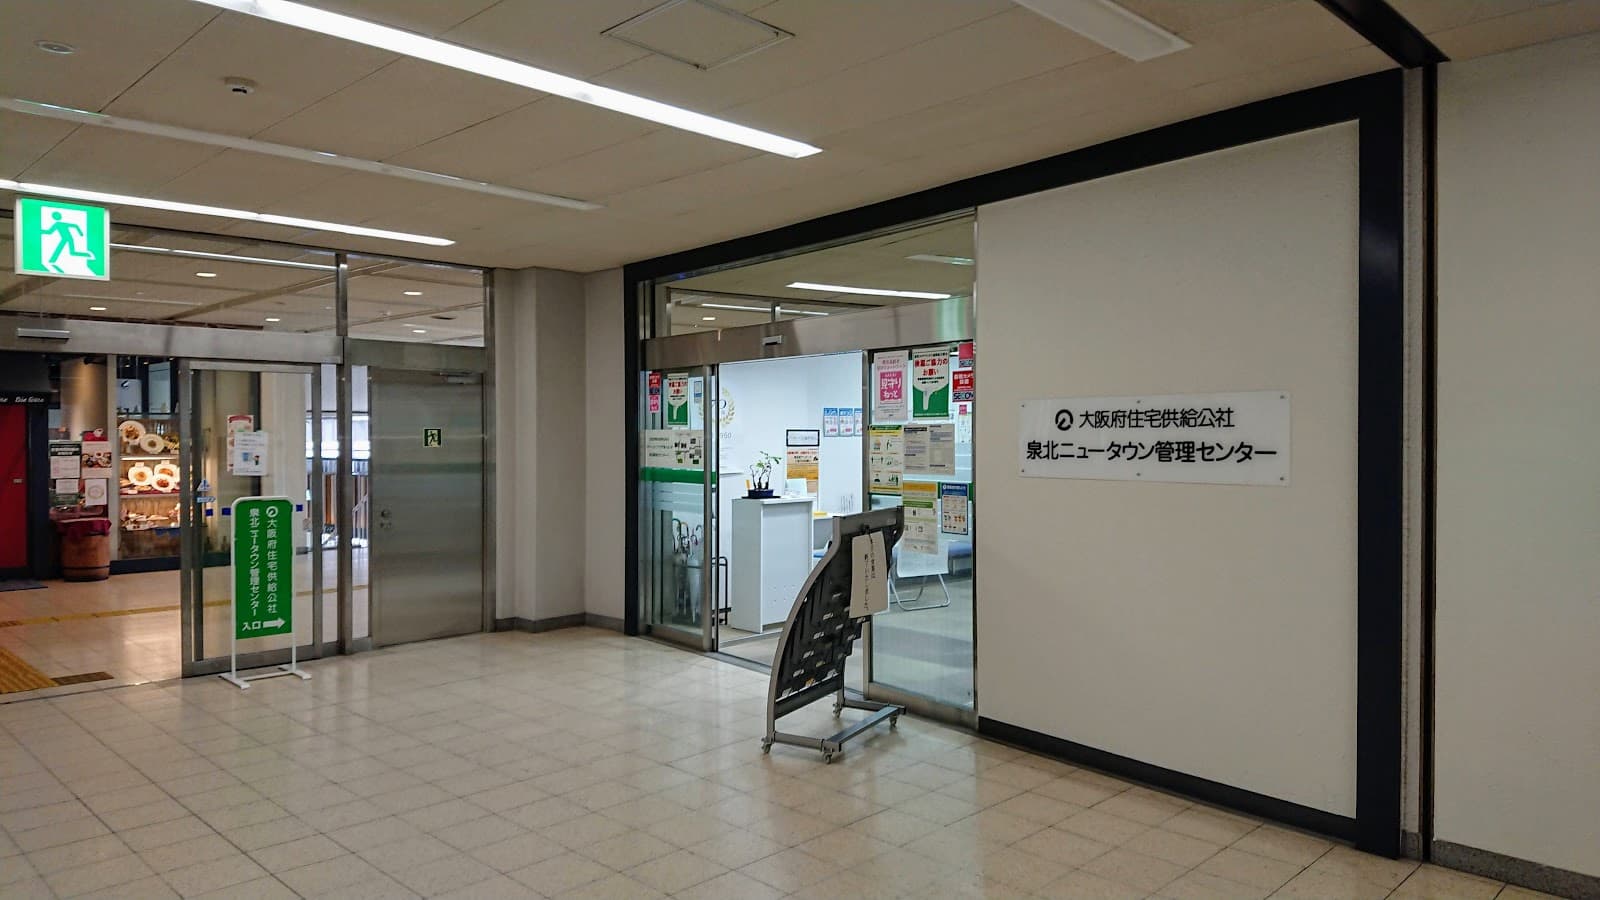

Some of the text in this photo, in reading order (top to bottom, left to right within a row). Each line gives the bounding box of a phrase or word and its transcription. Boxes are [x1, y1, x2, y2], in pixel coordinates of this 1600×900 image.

[881, 377, 902, 390] 見守り
[1079, 407, 1235, 429] 大阪府住宅供給公社
[1026, 440, 1277, 463] 泉北ニュータウン管理センター
[249, 508, 260, 616] 泉北ニュータウン管理センター
[266, 519, 278, 614] 大阪府住宅供給公社
[242, 620, 261, 631] 入口
